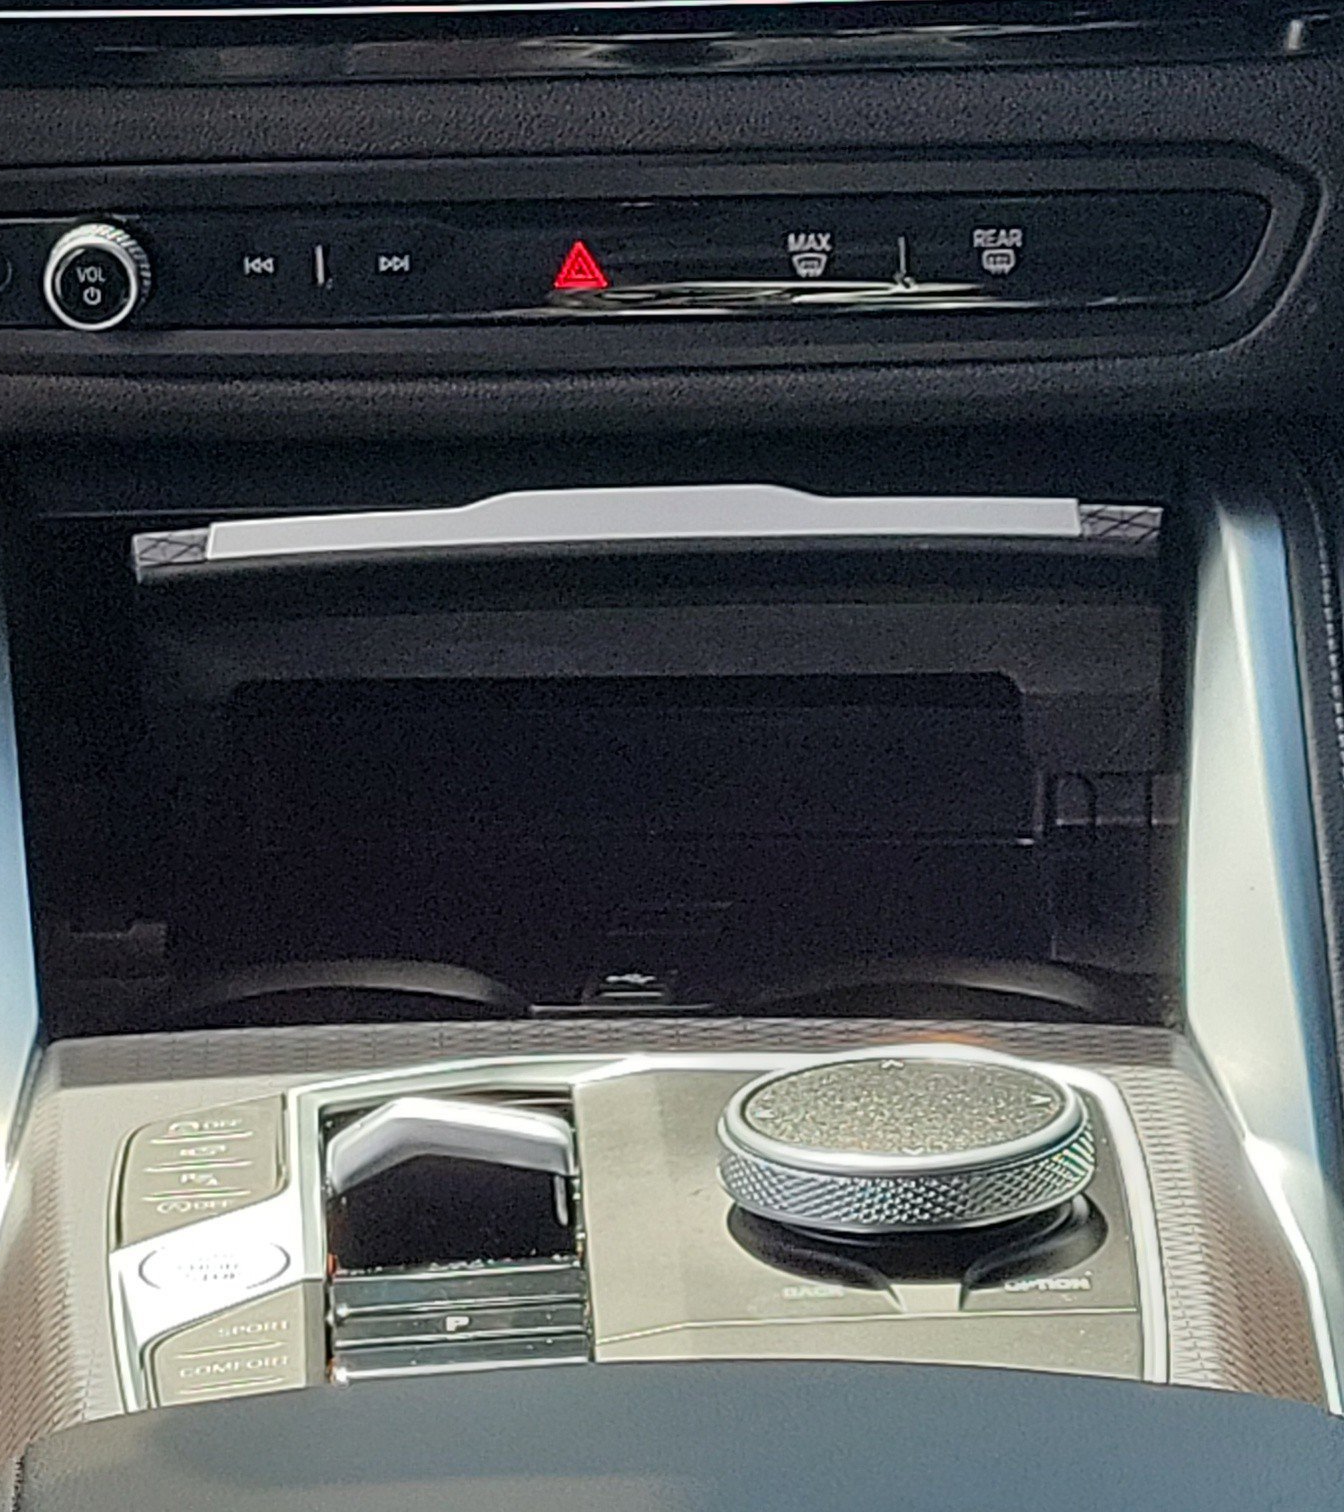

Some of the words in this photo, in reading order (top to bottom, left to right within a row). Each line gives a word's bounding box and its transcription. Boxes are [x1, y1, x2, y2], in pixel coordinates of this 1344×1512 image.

[788, 231, 832, 252] MAX
[972, 228, 1023, 248] REAR
[76, 265, 107, 285] VOL
[216, 1320, 290, 1338] SPORT
[445, 1314, 471, 1333] P
[178, 1355, 289, 1379] COMFORT
